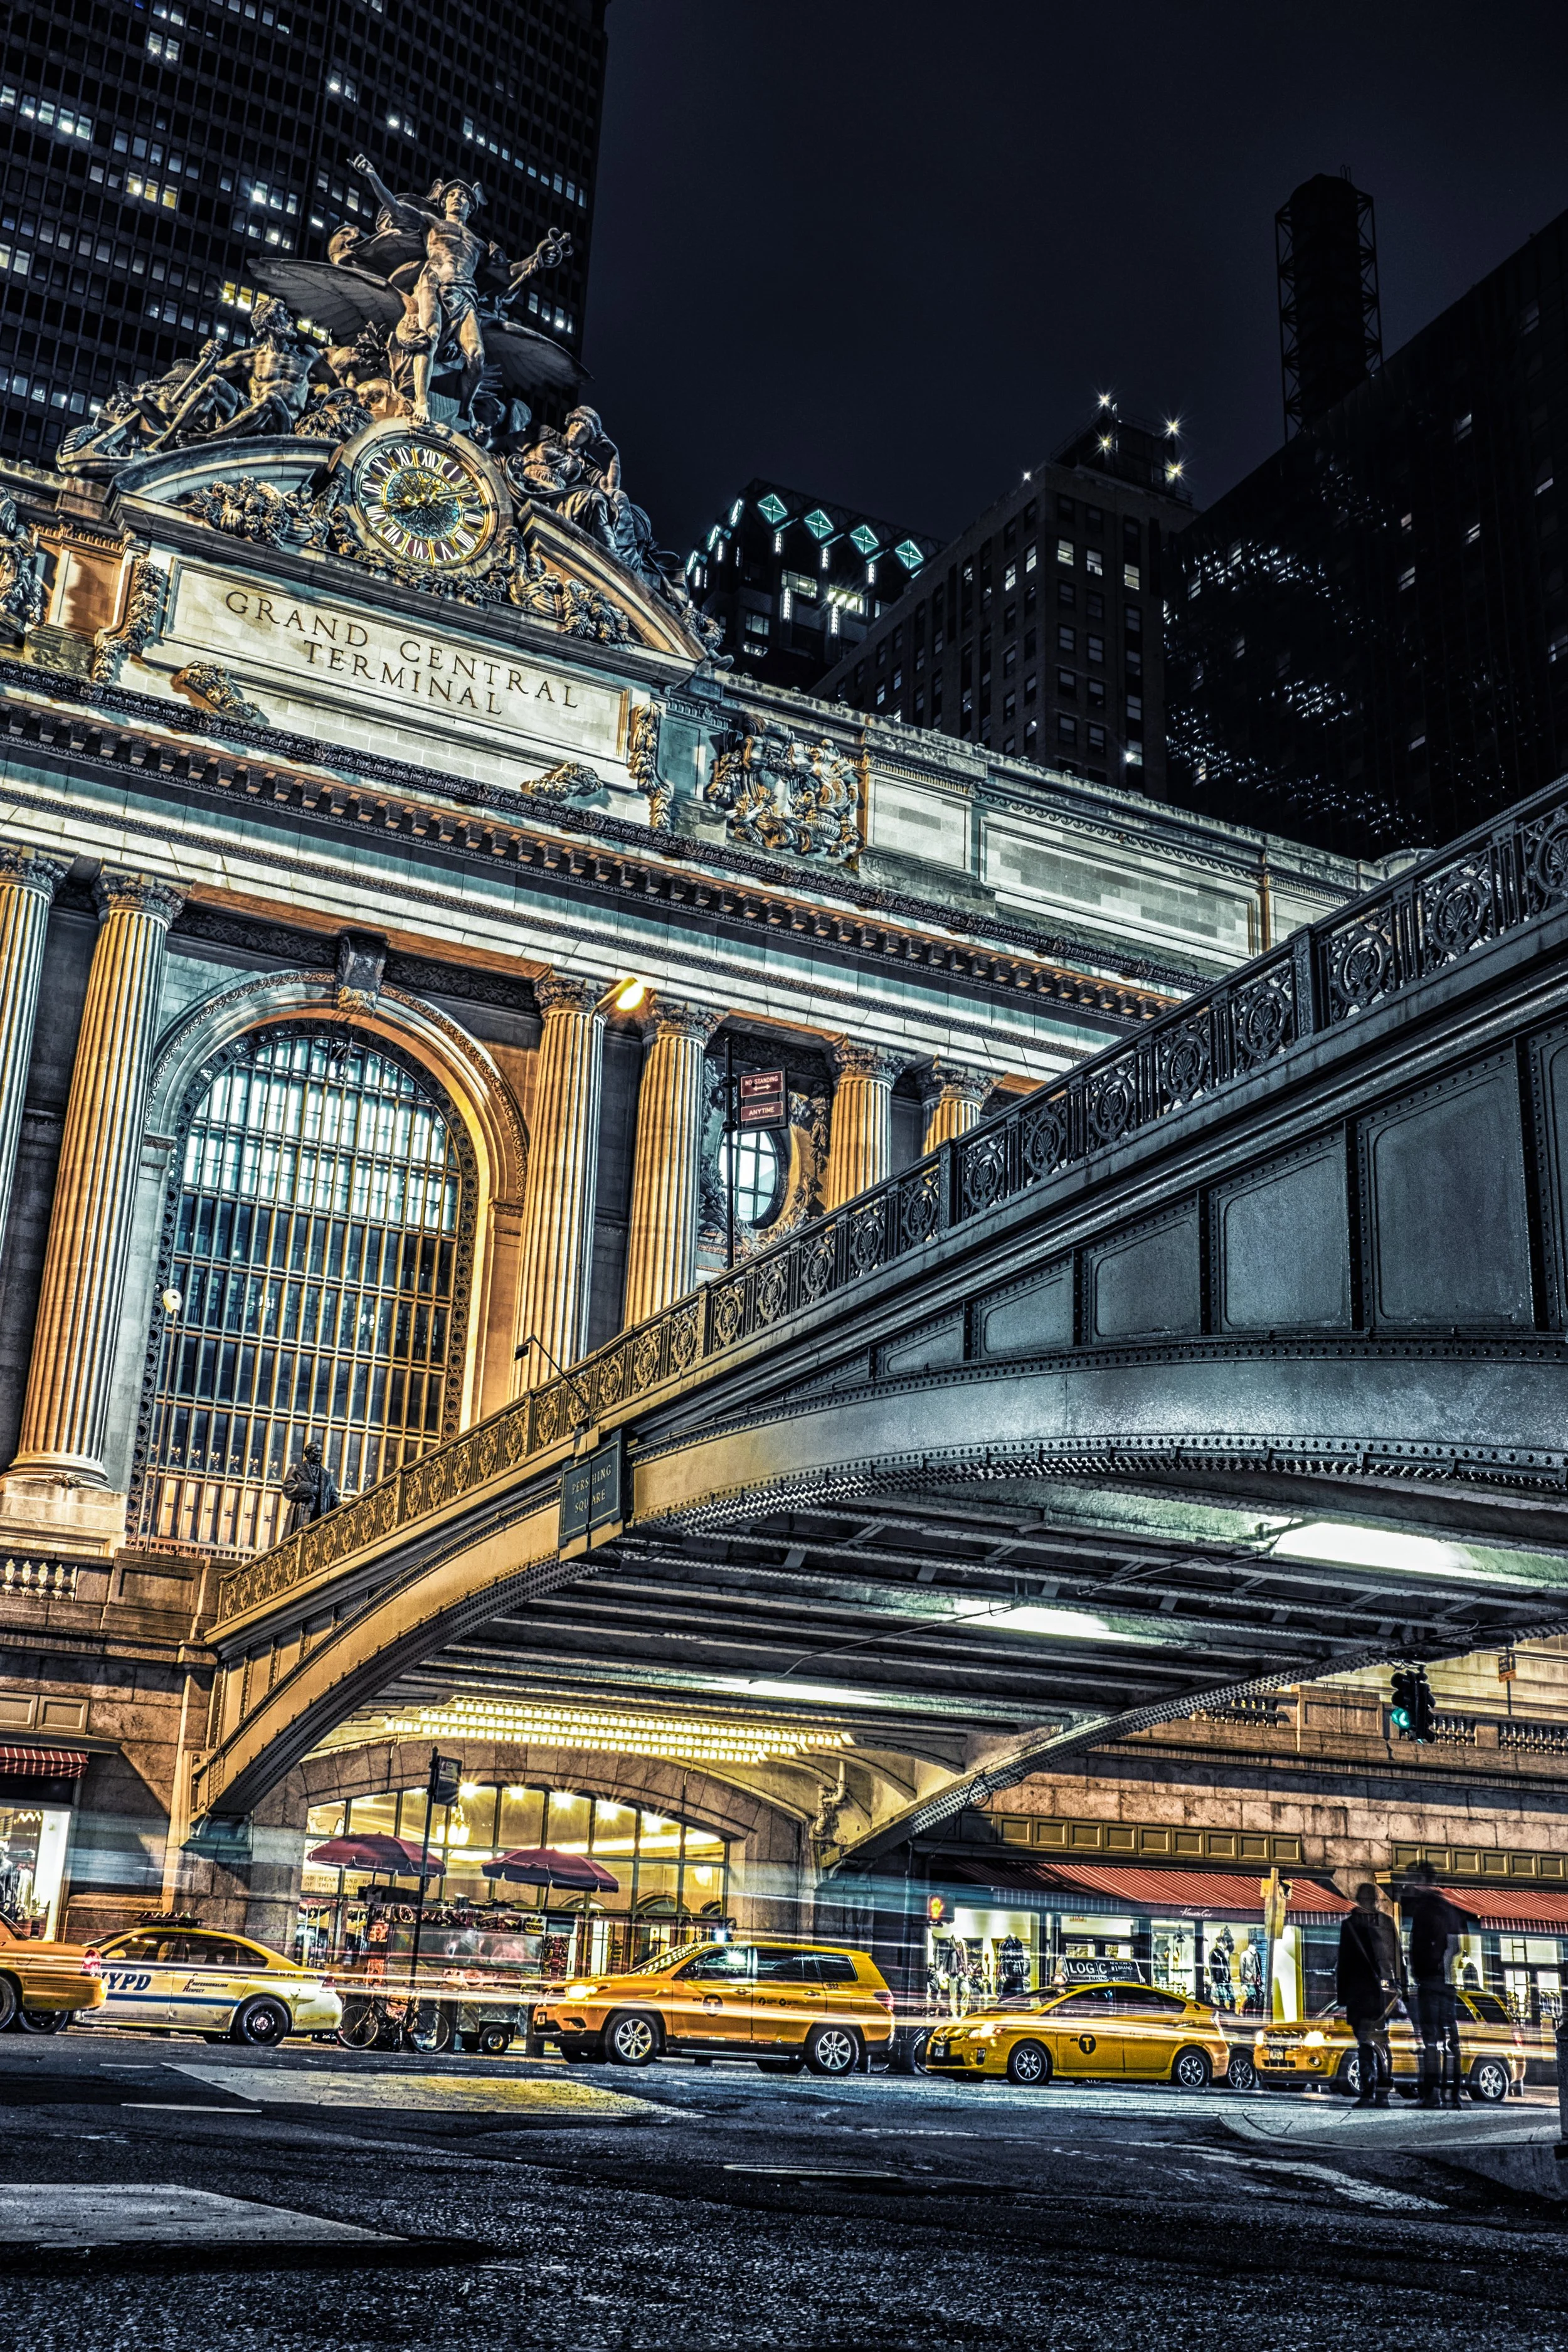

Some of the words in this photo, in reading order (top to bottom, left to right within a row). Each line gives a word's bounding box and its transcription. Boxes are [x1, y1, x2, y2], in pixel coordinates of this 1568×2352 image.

[395, 447, 410, 466] XI
[421, 448, 435, 468] XII
[371, 458, 391, 476] X
[447, 466, 459, 479] I
[362, 481, 382, 494] IX
[464, 512, 484, 525] III
[383, 526, 401, 545] VII
[411, 539, 423, 559] VI
[440, 542, 453, 560] V
[225, 590, 368, 647] GRAND
[400, 640, 578, 708] CENTRAL
[304, 640, 502, 715] TERMINAL
[754, 1076, 778, 1084] STANDING
[749, 1106, 775, 1116] ANYTIME
[571, 1464, 612, 1495] PERSHING
[575, 1489, 606, 1513] SQUARE
[1069, 1962, 1108, 1974] LOGIC
[1083, 2037, 1092, 2052] T
